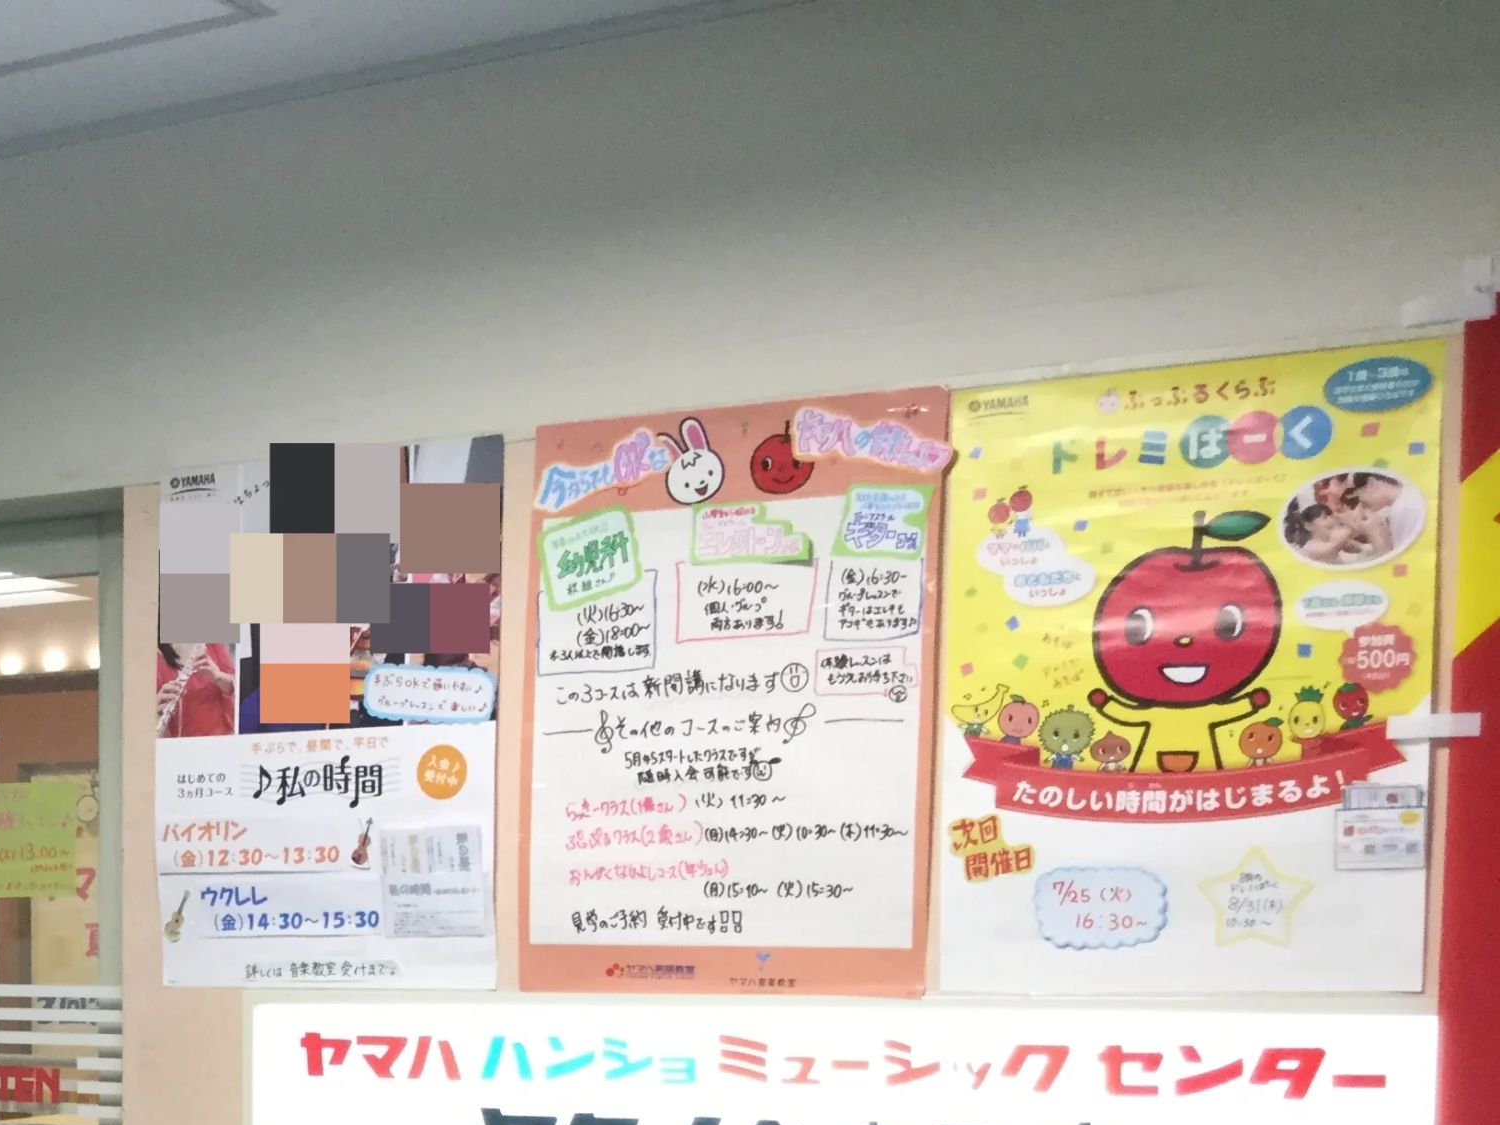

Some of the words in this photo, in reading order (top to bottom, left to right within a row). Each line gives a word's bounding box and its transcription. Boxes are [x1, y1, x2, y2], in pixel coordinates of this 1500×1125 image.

[983, 396, 1029, 411] YAMAHA
[181, 473, 215, 488] YAMAHA
[1356, 648, 1410, 669] 500円
[176, 773, 227, 785] はじめての
[276, 754, 384, 809] 私の時間
[1012, 769, 1346, 814] たのしい時間がはじまるよ!
[162, 819, 248, 843] バイオリン
[952, 816, 998, 850] 次回
[964, 847, 1033, 881] 開催日
[200, 886, 269, 907] ウクレレ
[1100, 886, 1133, 902] (火)
[300, 1032, 462, 1080] ヤマハ
[480, 1035, 697, 1085] ハンショ
[1097, 1045, 1387, 1100] センター
